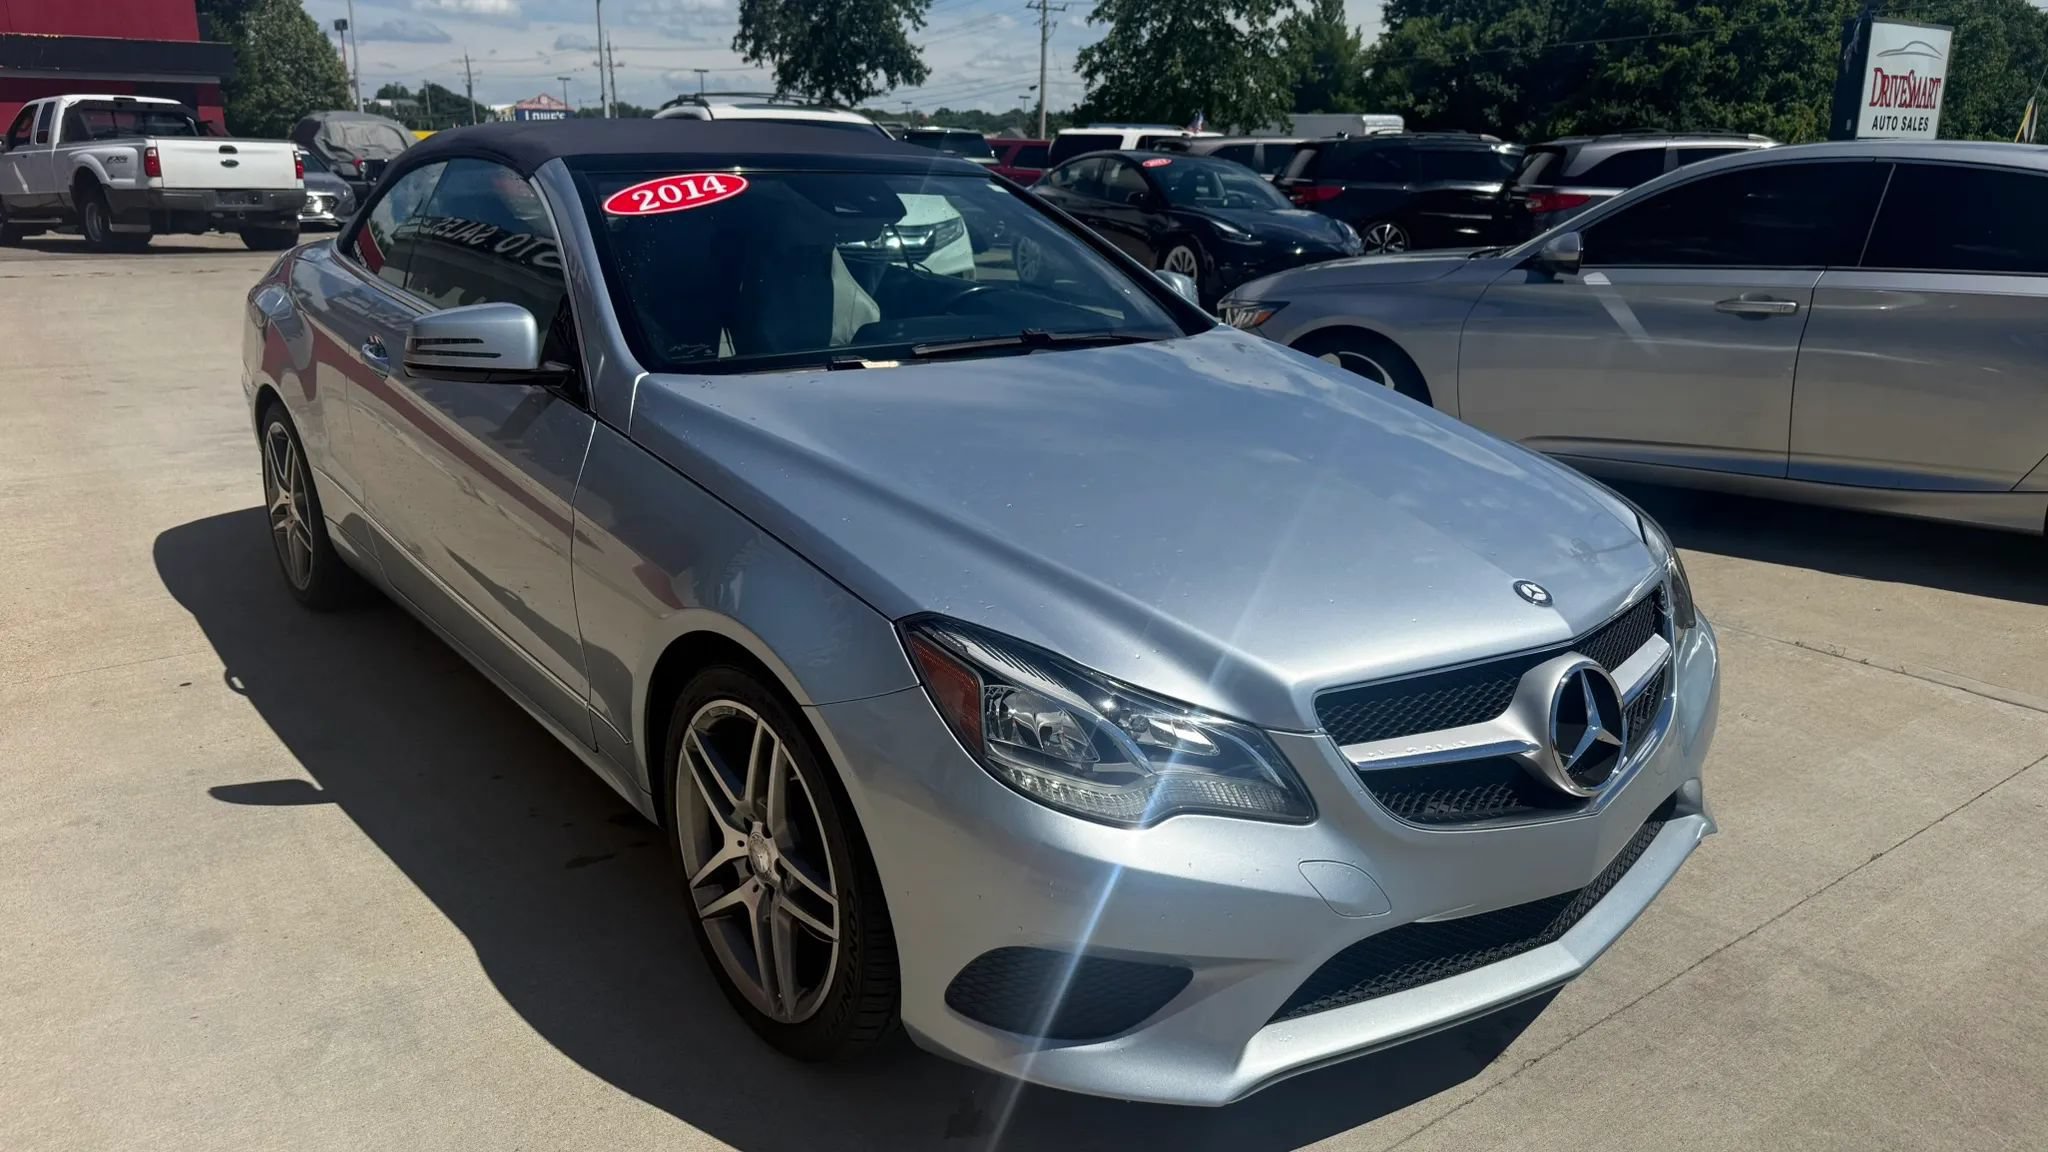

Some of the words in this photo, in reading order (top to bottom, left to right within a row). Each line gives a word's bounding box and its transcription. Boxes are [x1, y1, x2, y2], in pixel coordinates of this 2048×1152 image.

[1872, 115, 1898, 131] AUTO
[1900, 116, 1929, 132] SALES
[631, 175, 727, 212] 2014
